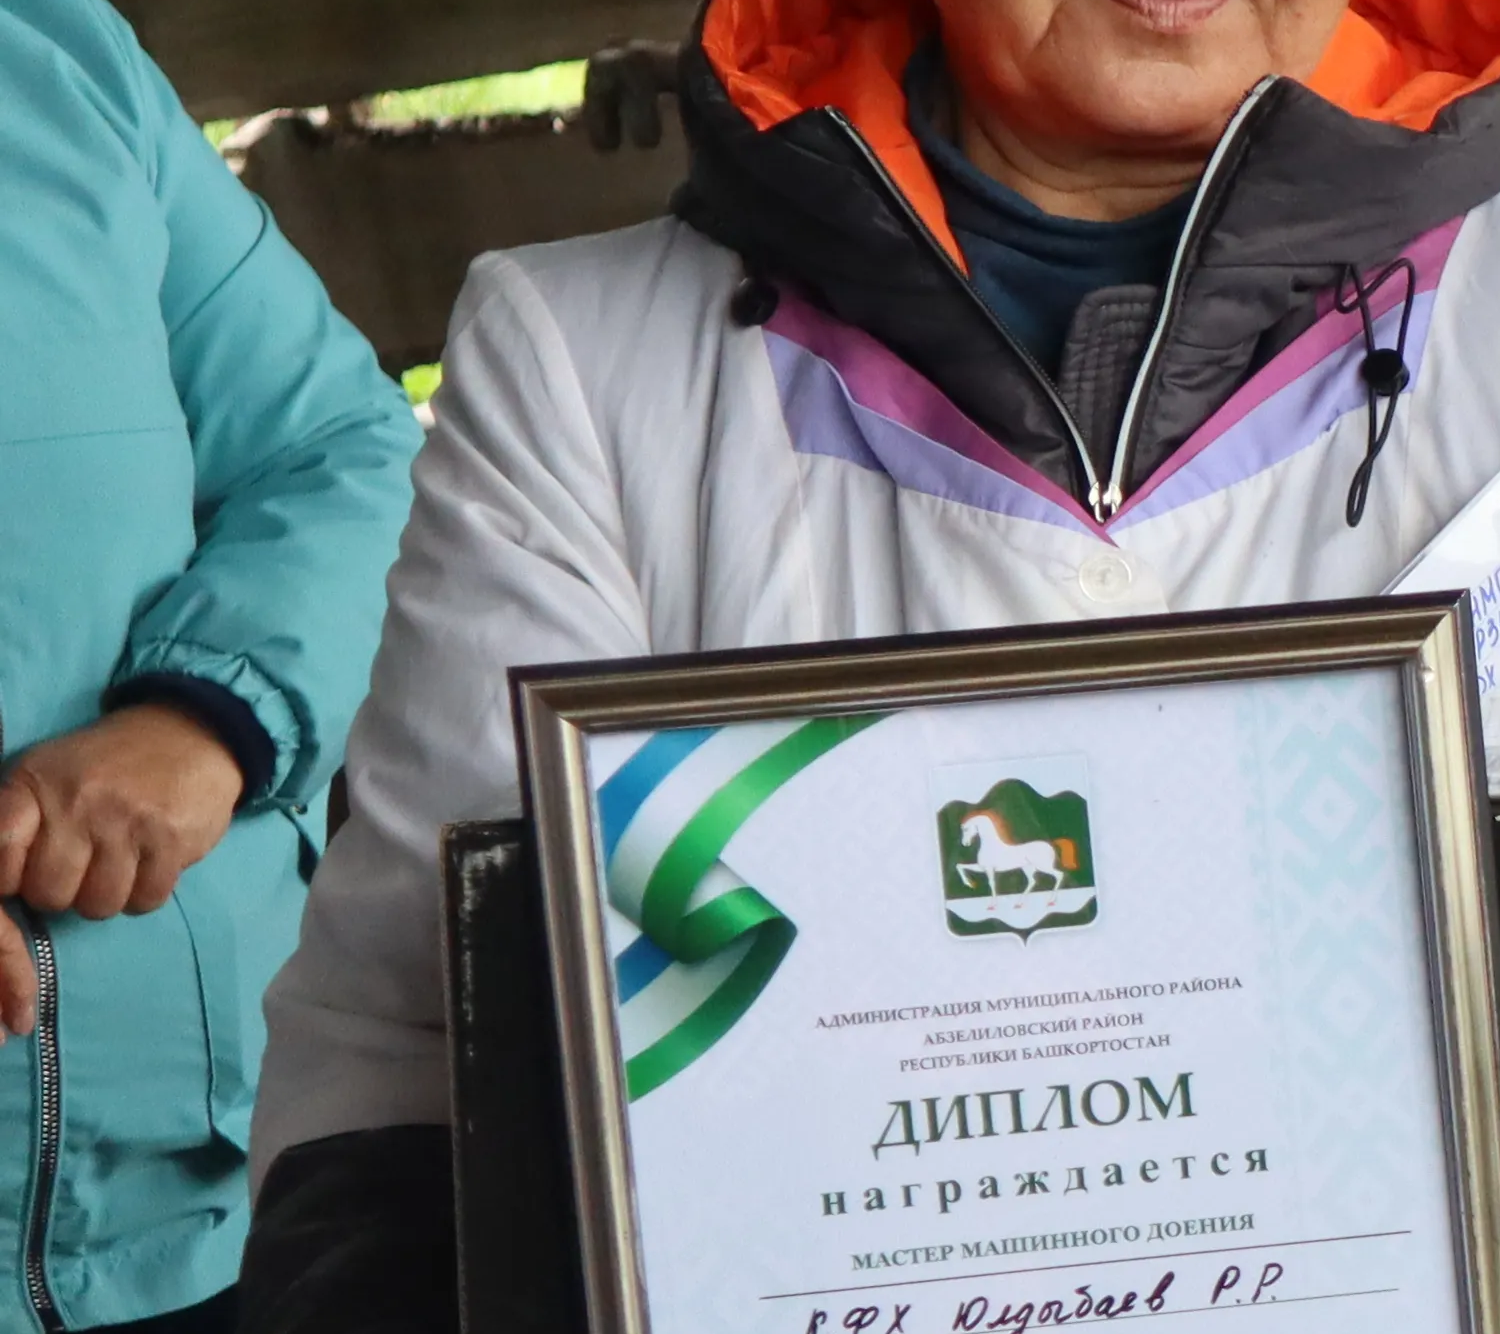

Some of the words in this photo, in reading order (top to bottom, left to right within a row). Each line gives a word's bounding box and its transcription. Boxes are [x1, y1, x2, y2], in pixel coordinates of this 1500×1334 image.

[816, 1001, 982, 1029] АДМИНИСТРАЦИЯ
[987, 982, 1164, 1012] МУНИЦИПАЛЬНОГО
[1169, 977, 1242, 995] РАЙОНА
[924, 1016, 1077, 1046] АБЗЕЛИЛОВСКИЙ
[1082, 1012, 1144, 1030] РАЙОН
[900, 1047, 1017, 1072] РЕСПУБЛИКИ
[1022, 1034, 1171, 1061] БАШКОРТОСТАН
[871, 1072, 1197, 1159] ДИПЛОМ
[851, 1245, 954, 1271] МАСТЕР
[961, 1225, 1140, 1258] МАШИННОГО
[1147, 1213, 1254, 1242] ДОЕНИЯ
